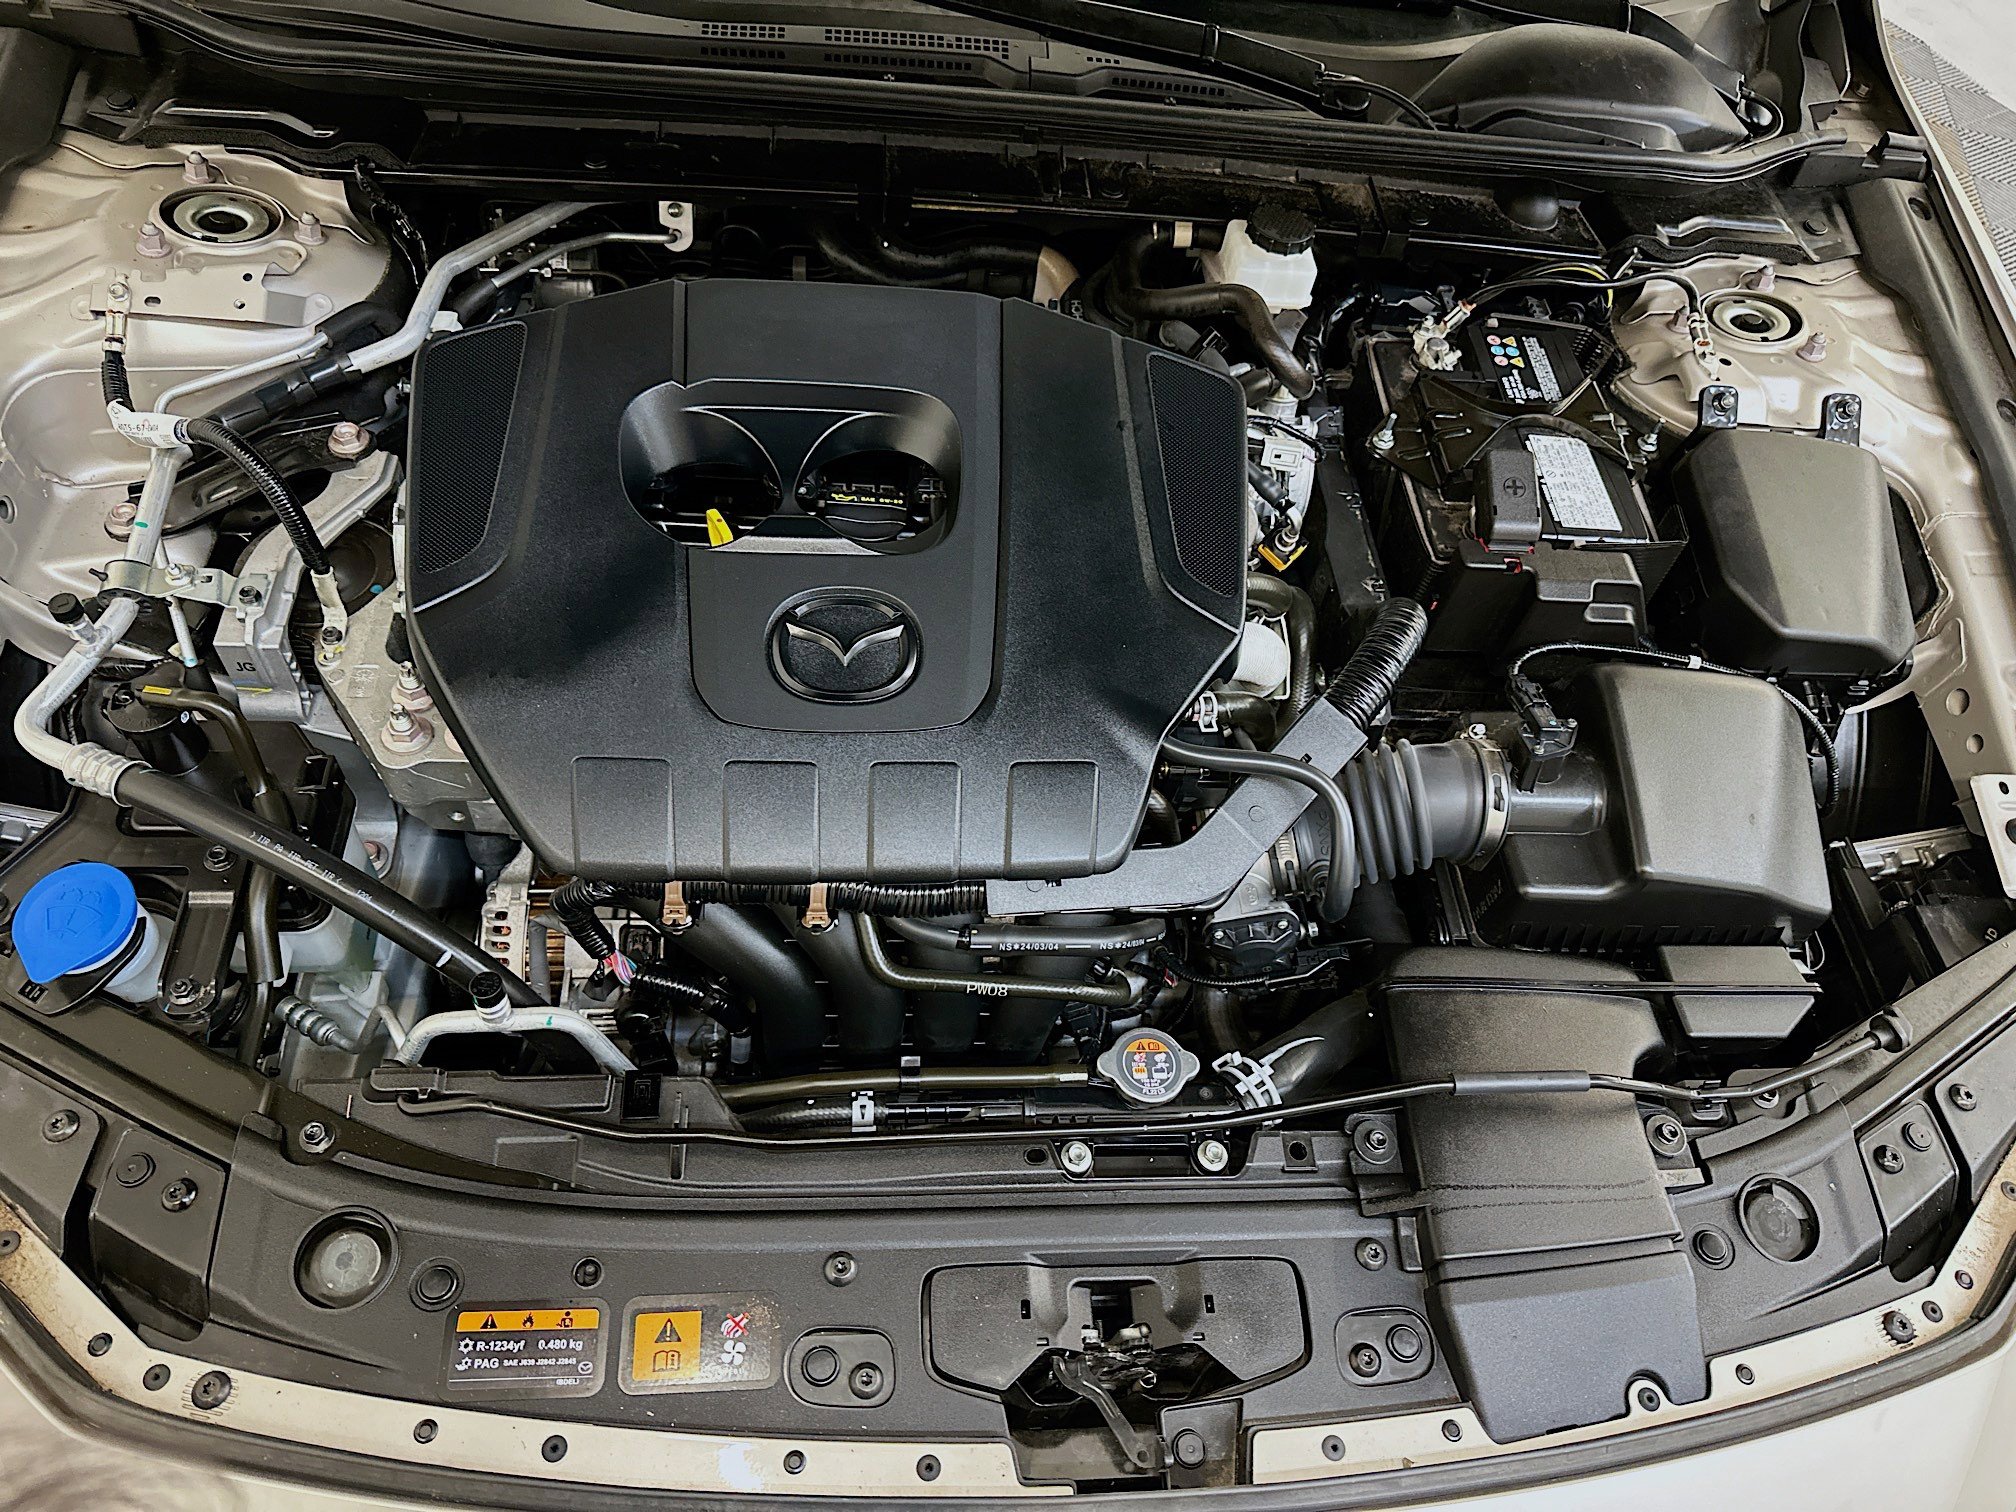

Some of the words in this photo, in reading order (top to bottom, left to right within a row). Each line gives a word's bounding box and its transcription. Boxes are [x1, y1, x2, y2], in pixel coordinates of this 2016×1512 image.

[236, 661, 256, 672] JG
[966, 981, 1008, 997] PW08
[475, 1340, 526, 1353] R-1234yf
[537, 1339, 567, 1350] 0.480
[568, 1338, 583, 1351] kg
[473, 1358, 499, 1369] PAG
[503, 1359, 518, 1367] SAE
